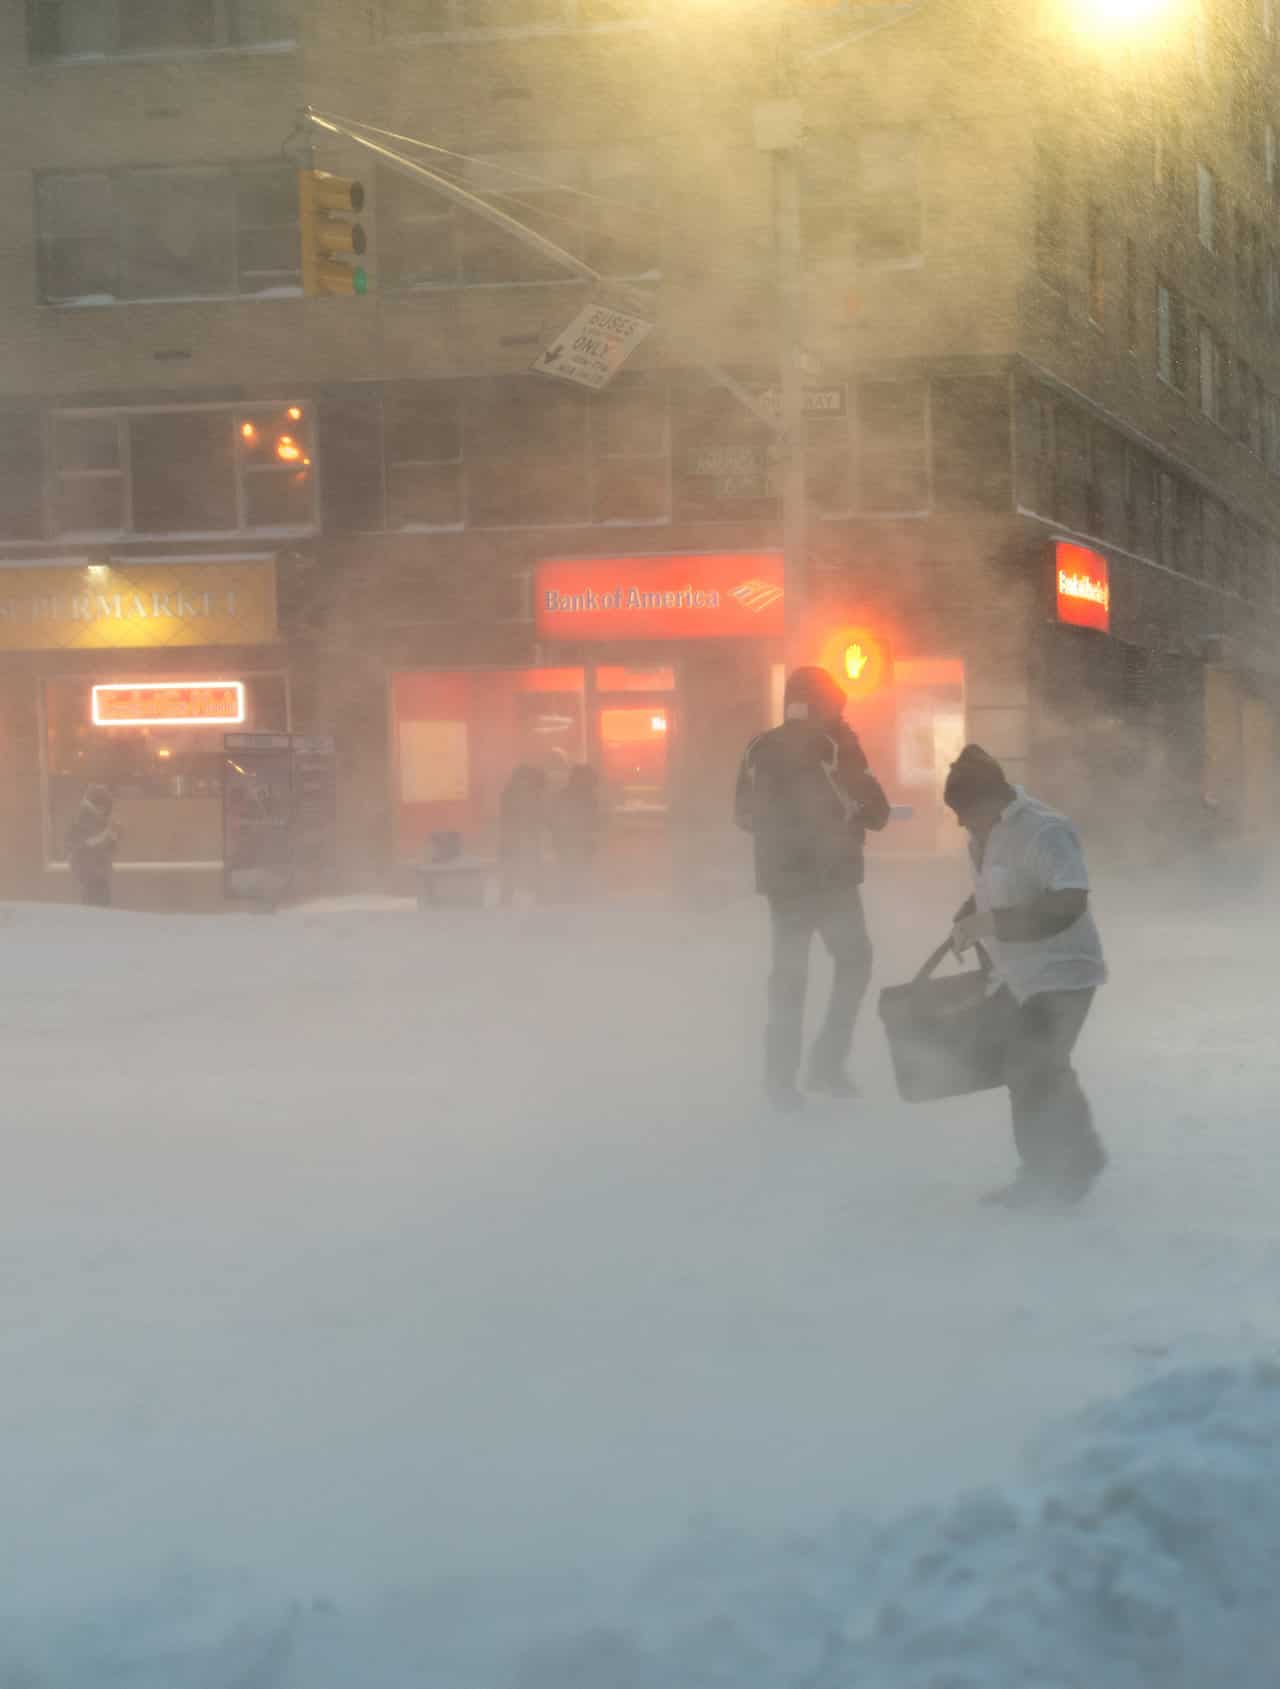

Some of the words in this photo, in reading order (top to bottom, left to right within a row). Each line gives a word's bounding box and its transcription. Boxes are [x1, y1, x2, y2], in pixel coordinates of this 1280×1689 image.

[590, 309, 635, 336] BUSES
[573, 335, 609, 357] ONLY
[544, 586, 600, 612] Bank
[601, 584, 623, 609] of
[626, 584, 720, 609] America
